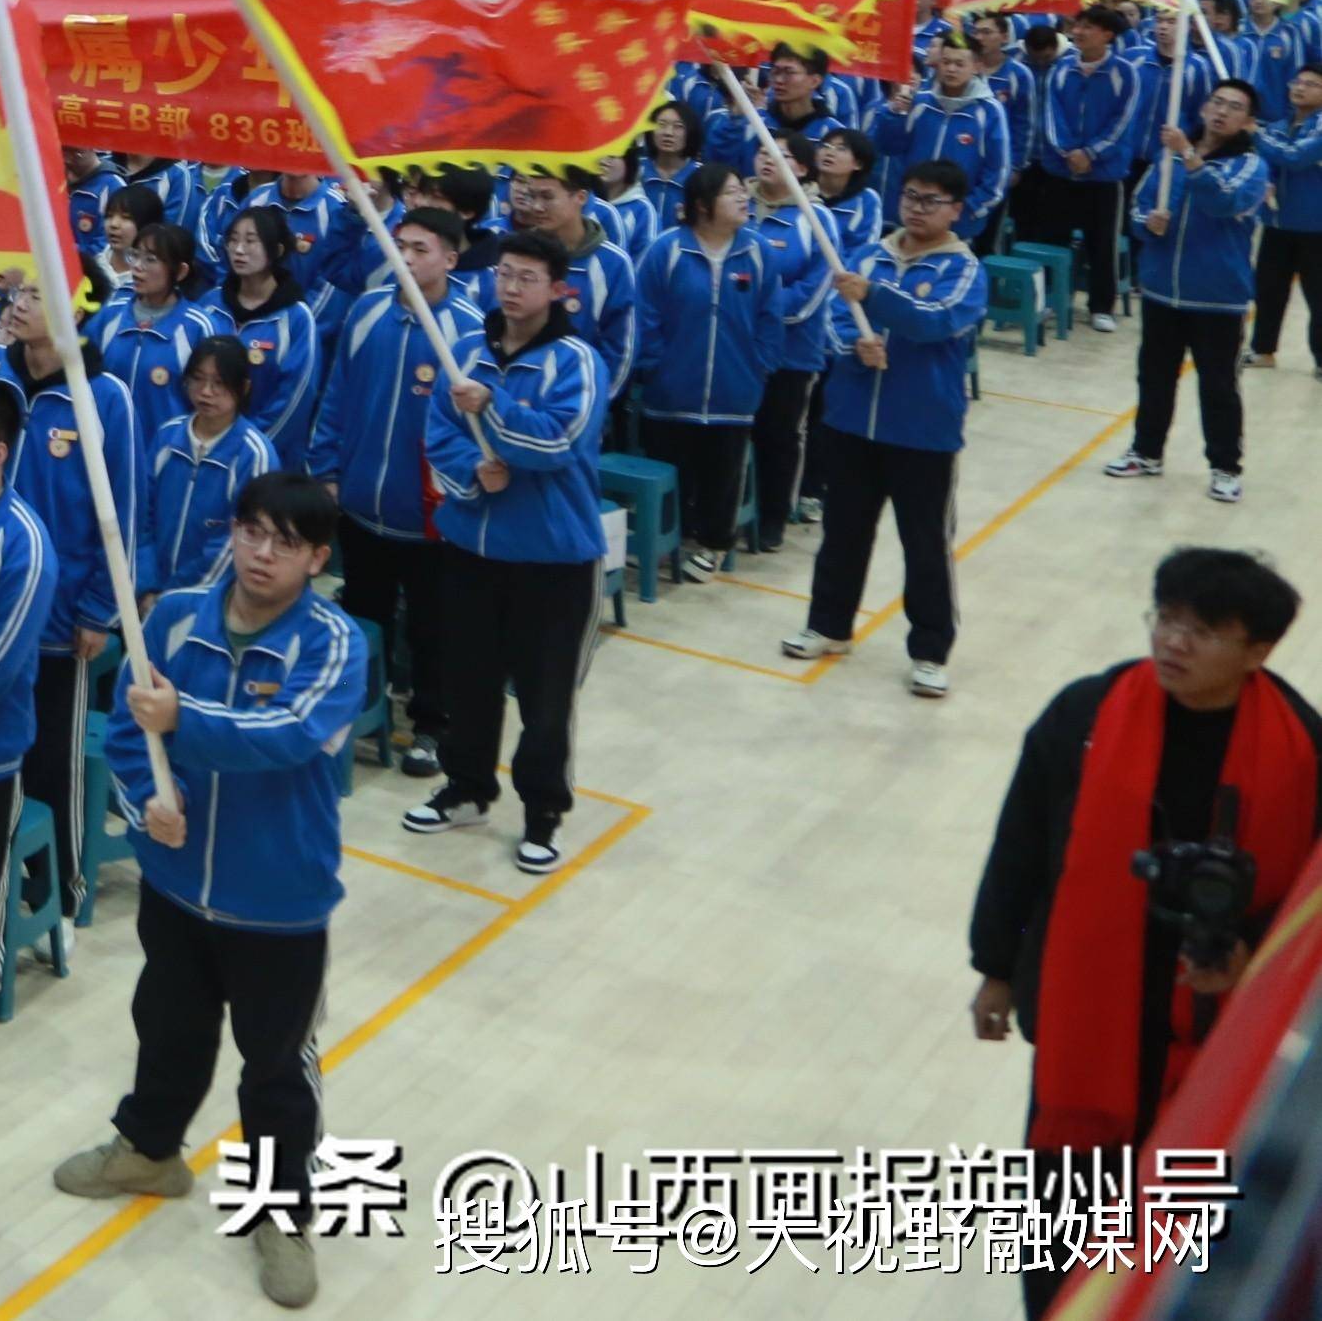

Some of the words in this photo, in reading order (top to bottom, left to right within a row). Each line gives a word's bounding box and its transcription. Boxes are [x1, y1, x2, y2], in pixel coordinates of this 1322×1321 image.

[57, 94, 191, 140] 高三B部
[209, 113, 323, 153] 836班
